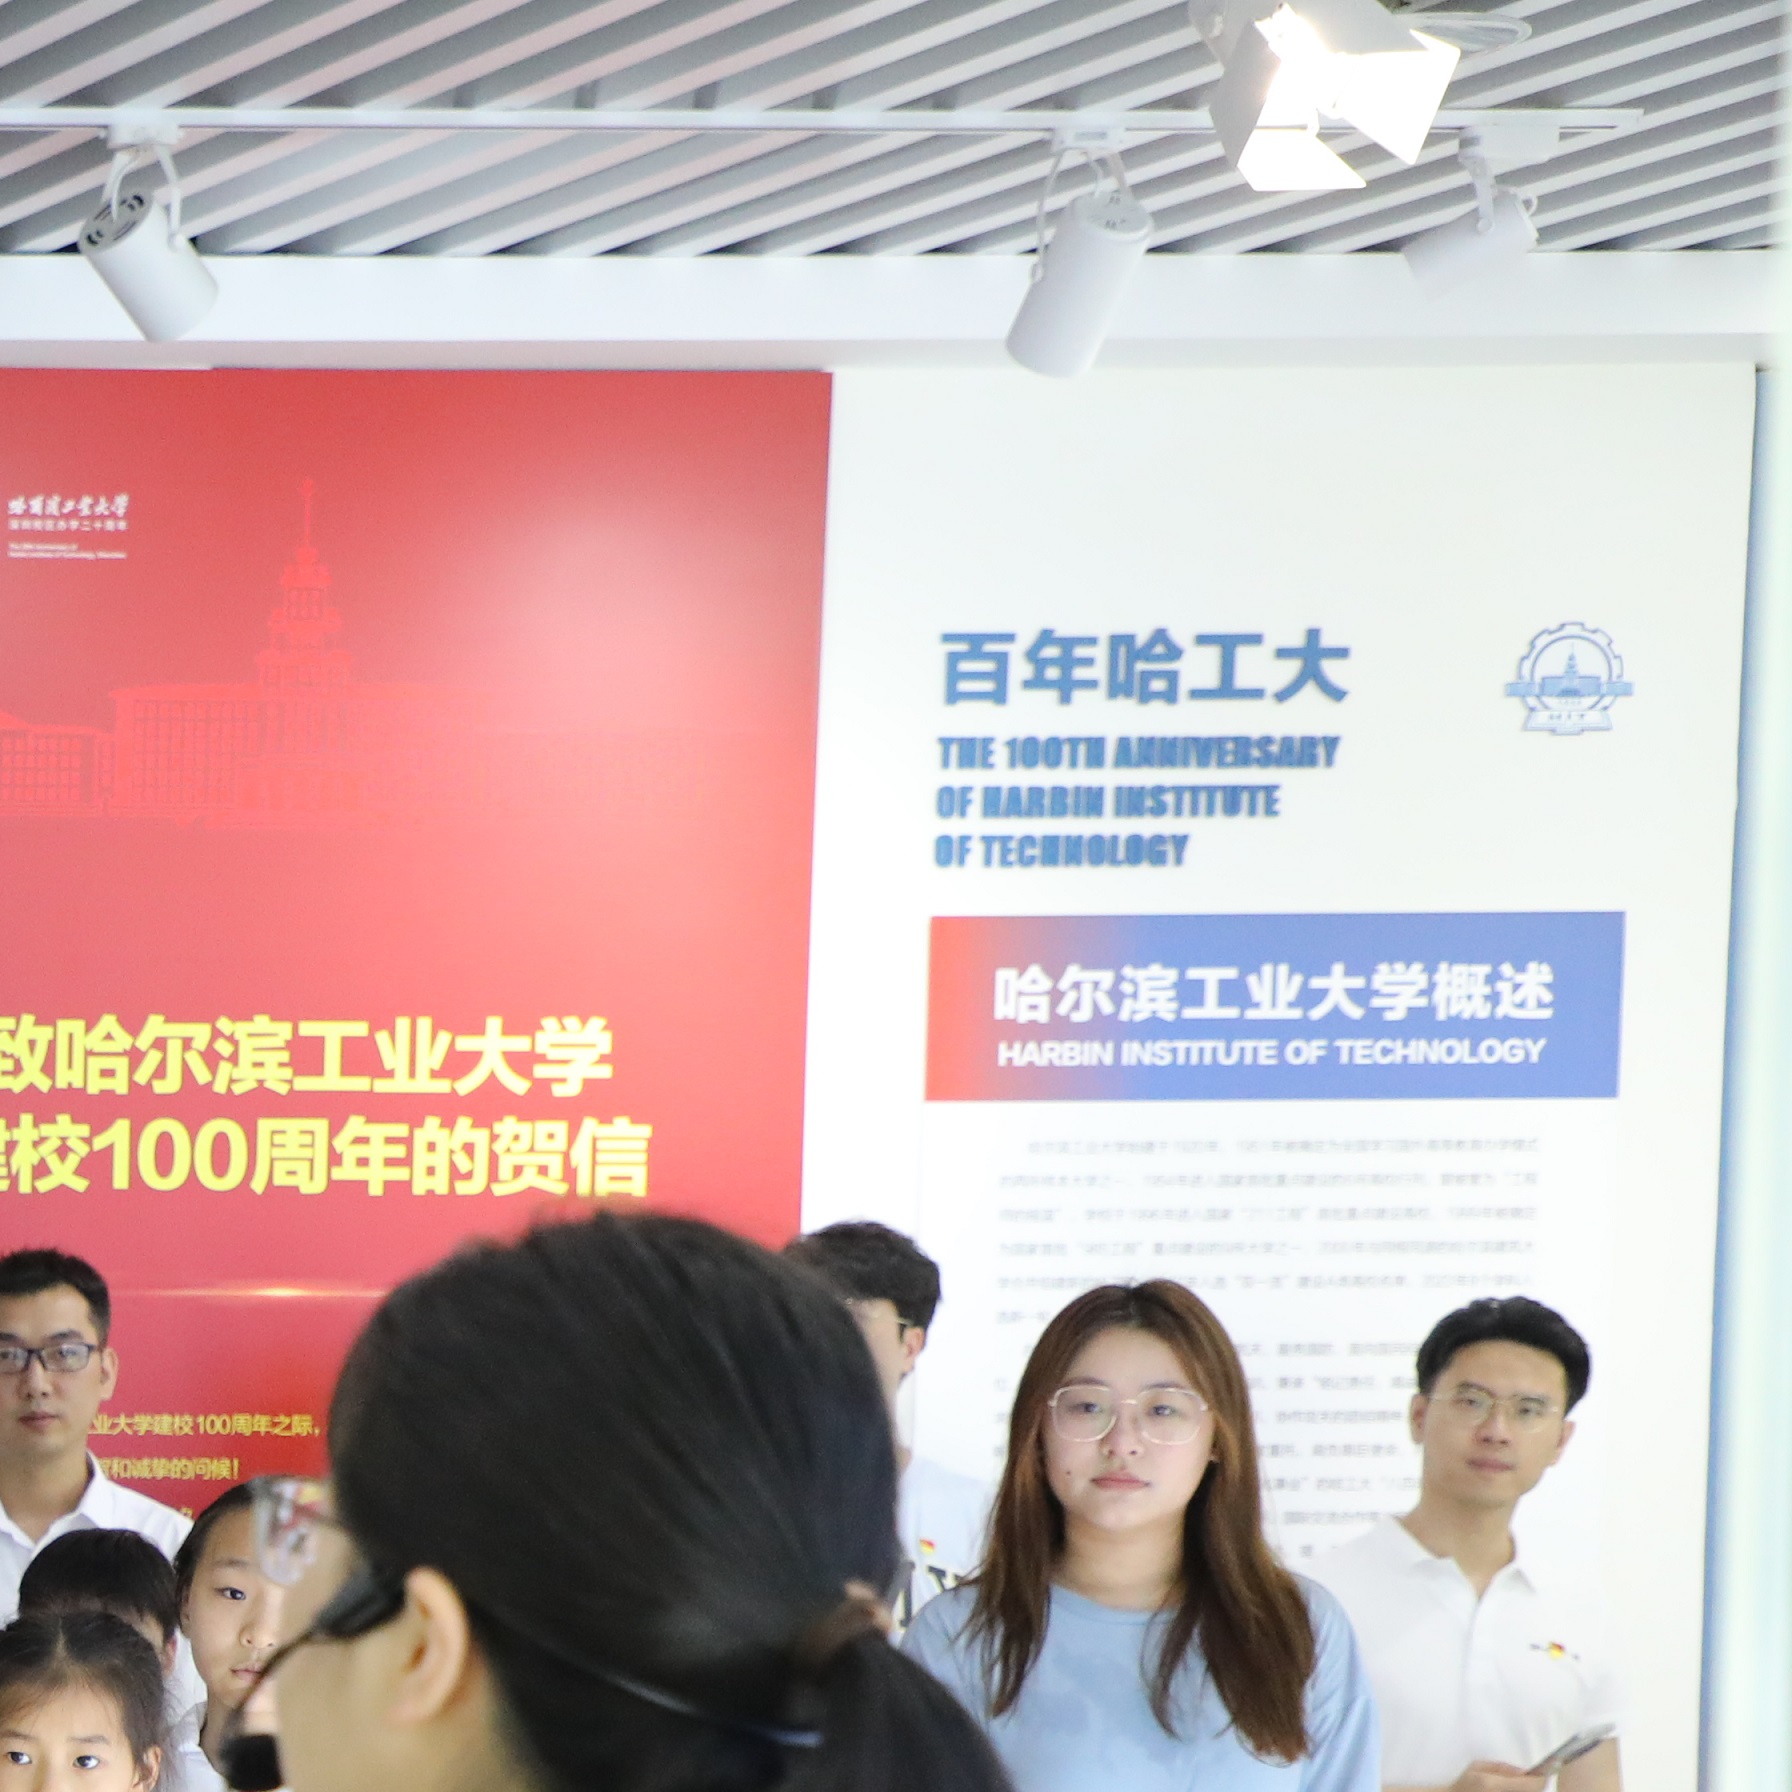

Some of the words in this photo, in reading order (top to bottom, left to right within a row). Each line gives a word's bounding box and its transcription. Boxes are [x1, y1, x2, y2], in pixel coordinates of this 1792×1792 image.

[940, 628, 1351, 706] 百年哈工大
[938, 736, 996, 770] THE
[1004, 735, 1107, 770] 100TH
[1112, 735, 1342, 770] ANNIVERSARY
[936, 785, 974, 819] OF
[981, 785, 1106, 819] HARBIN
[1114, 784, 1281, 818] INSTITUTE
[934, 834, 973, 868] OF
[979, 833, 1191, 867] TECHNOLOGY
[994, 962, 1554, 1024] 哈尔滨工业大学概述
[998, 1041, 1115, 1068] HARBIN
[1121, 1040, 1279, 1067] INSTITUTE
[1284, 1039, 1328, 1066] OF
[1334, 1037, 1548, 1066] TECHNOLOGY
